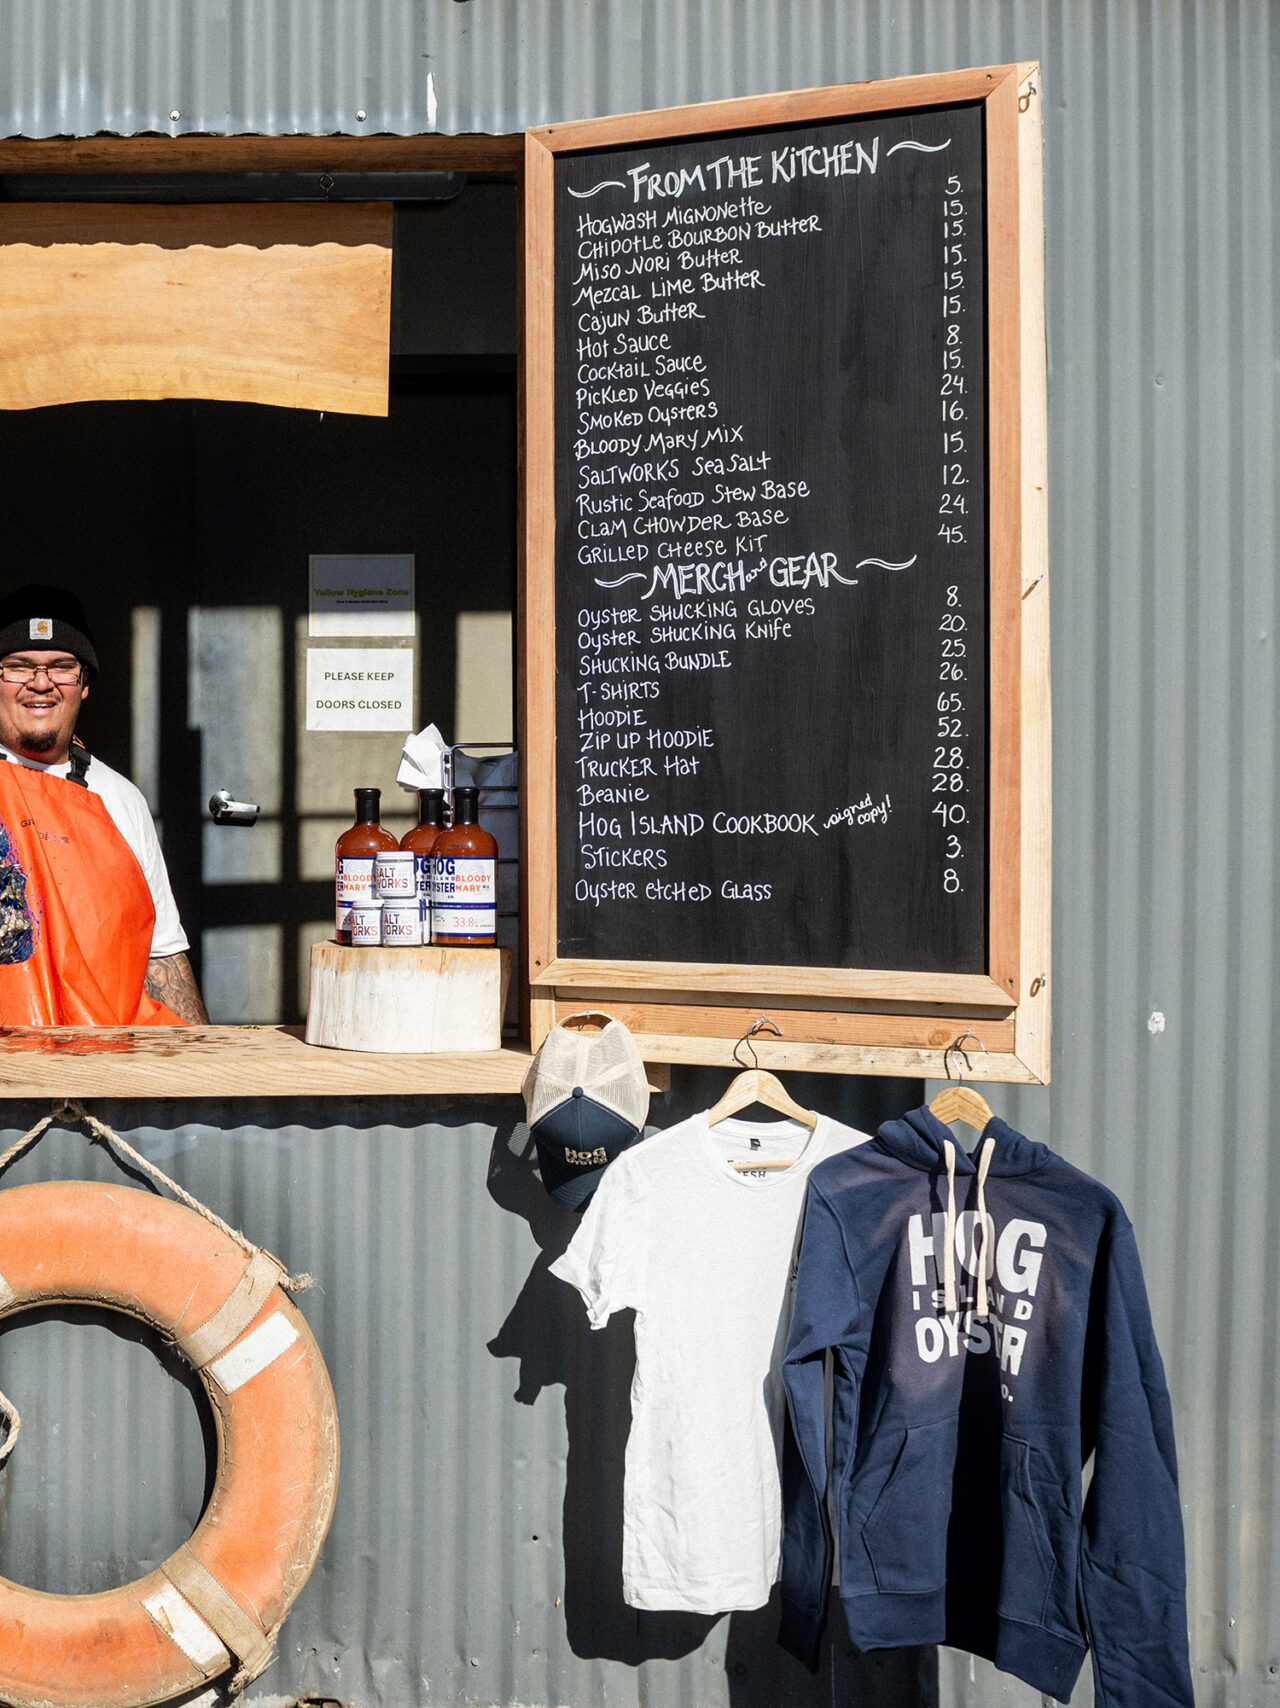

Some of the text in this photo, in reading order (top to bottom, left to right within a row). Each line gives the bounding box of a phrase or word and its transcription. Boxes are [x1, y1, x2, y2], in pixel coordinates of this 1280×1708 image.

[627, 162, 706, 203] FROM
[706, 156, 763, 190] THE
[613, 333, 671, 354] Sauce
[656, 355, 707, 375] Sauce
[692, 457, 724, 476] Sea
[576, 494, 632, 516] Rustic
[712, 484, 756, 503] Stew
[760, 480, 810, 499] Base
[736, 509, 789, 527] Base
[641, 552, 858, 601] MERCH and GEAR
[346, 588, 384, 598] Hygiene
[386, 588, 409, 596] Zone
[324, 672, 395, 681] PLEASE KEEP
[316, 700, 402, 709] DOORS CLOSED
[664, 756, 699, 776] Hat
[823, 793, 872, 828] signed
[857, 794, 892, 824] copy!
[631, 811, 704, 836] ISLAND
[343, 874, 372, 882] BLOOD
[455, 874, 491, 882] BLOODY
[455, 884, 481, 892] MARY
[384, 914, 400, 925] ALT
[453, 916, 475, 928] 33.8
[353, 925, 378, 936] ORKS
[908, 1211, 1048, 1296] HOG
[1001, 1383, 1014, 1402] O.
